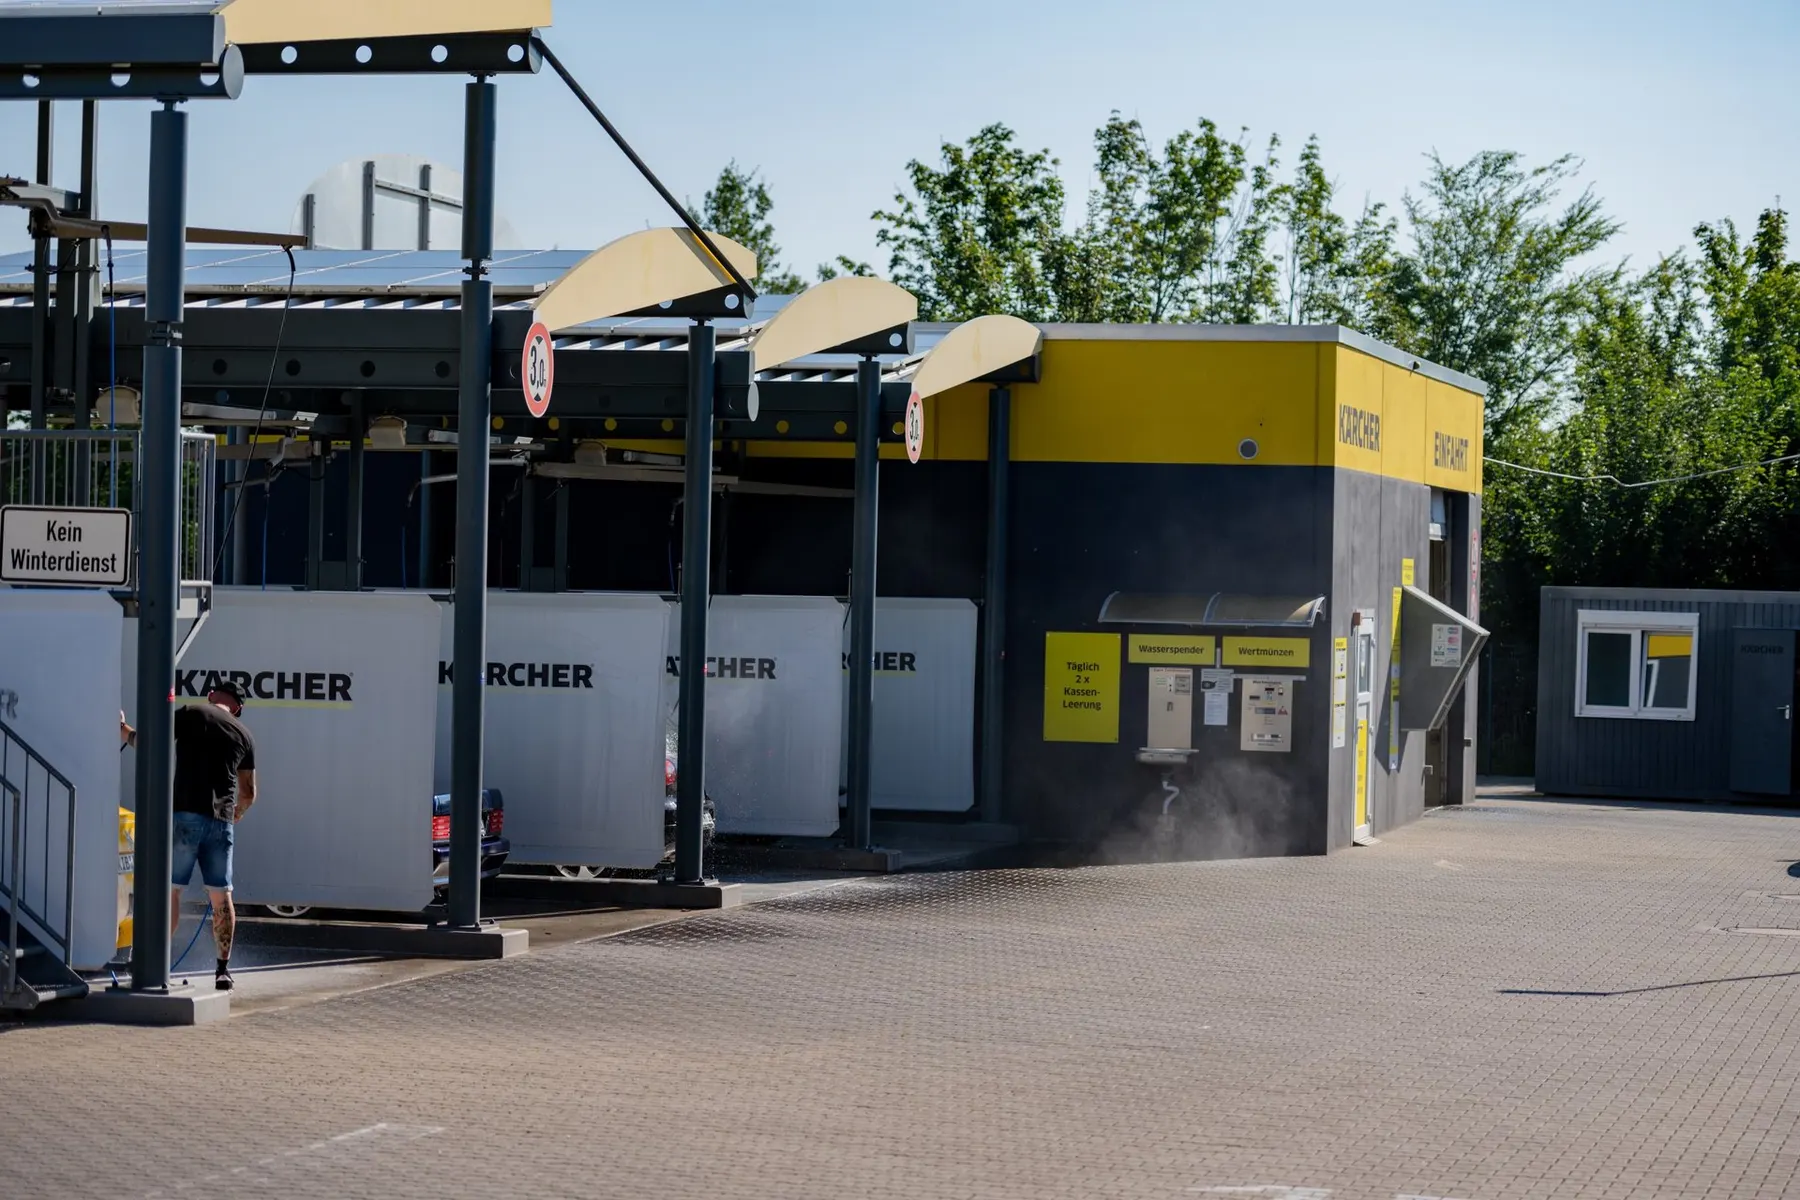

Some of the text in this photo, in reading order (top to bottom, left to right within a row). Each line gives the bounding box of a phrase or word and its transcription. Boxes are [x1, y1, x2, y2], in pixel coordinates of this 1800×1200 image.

[1339, 403, 1380, 453] KÄRCHER
[1434, 431, 1468, 472] EINFAHRT
[46, 520, 82, 542] Kein
[11, 548, 117, 573] Winterdienst
[1138, 644, 1204, 656] Wasserspender
[1238, 646, 1294, 657] Wertmünzen
[1066, 661, 1099, 672] Täglich
[438, 661, 593, 688] KRCHER
[1075, 675, 1082, 684] 2
[1064, 687, 1101, 697] Kassen-
[1062, 700, 1101, 711] Leerung
